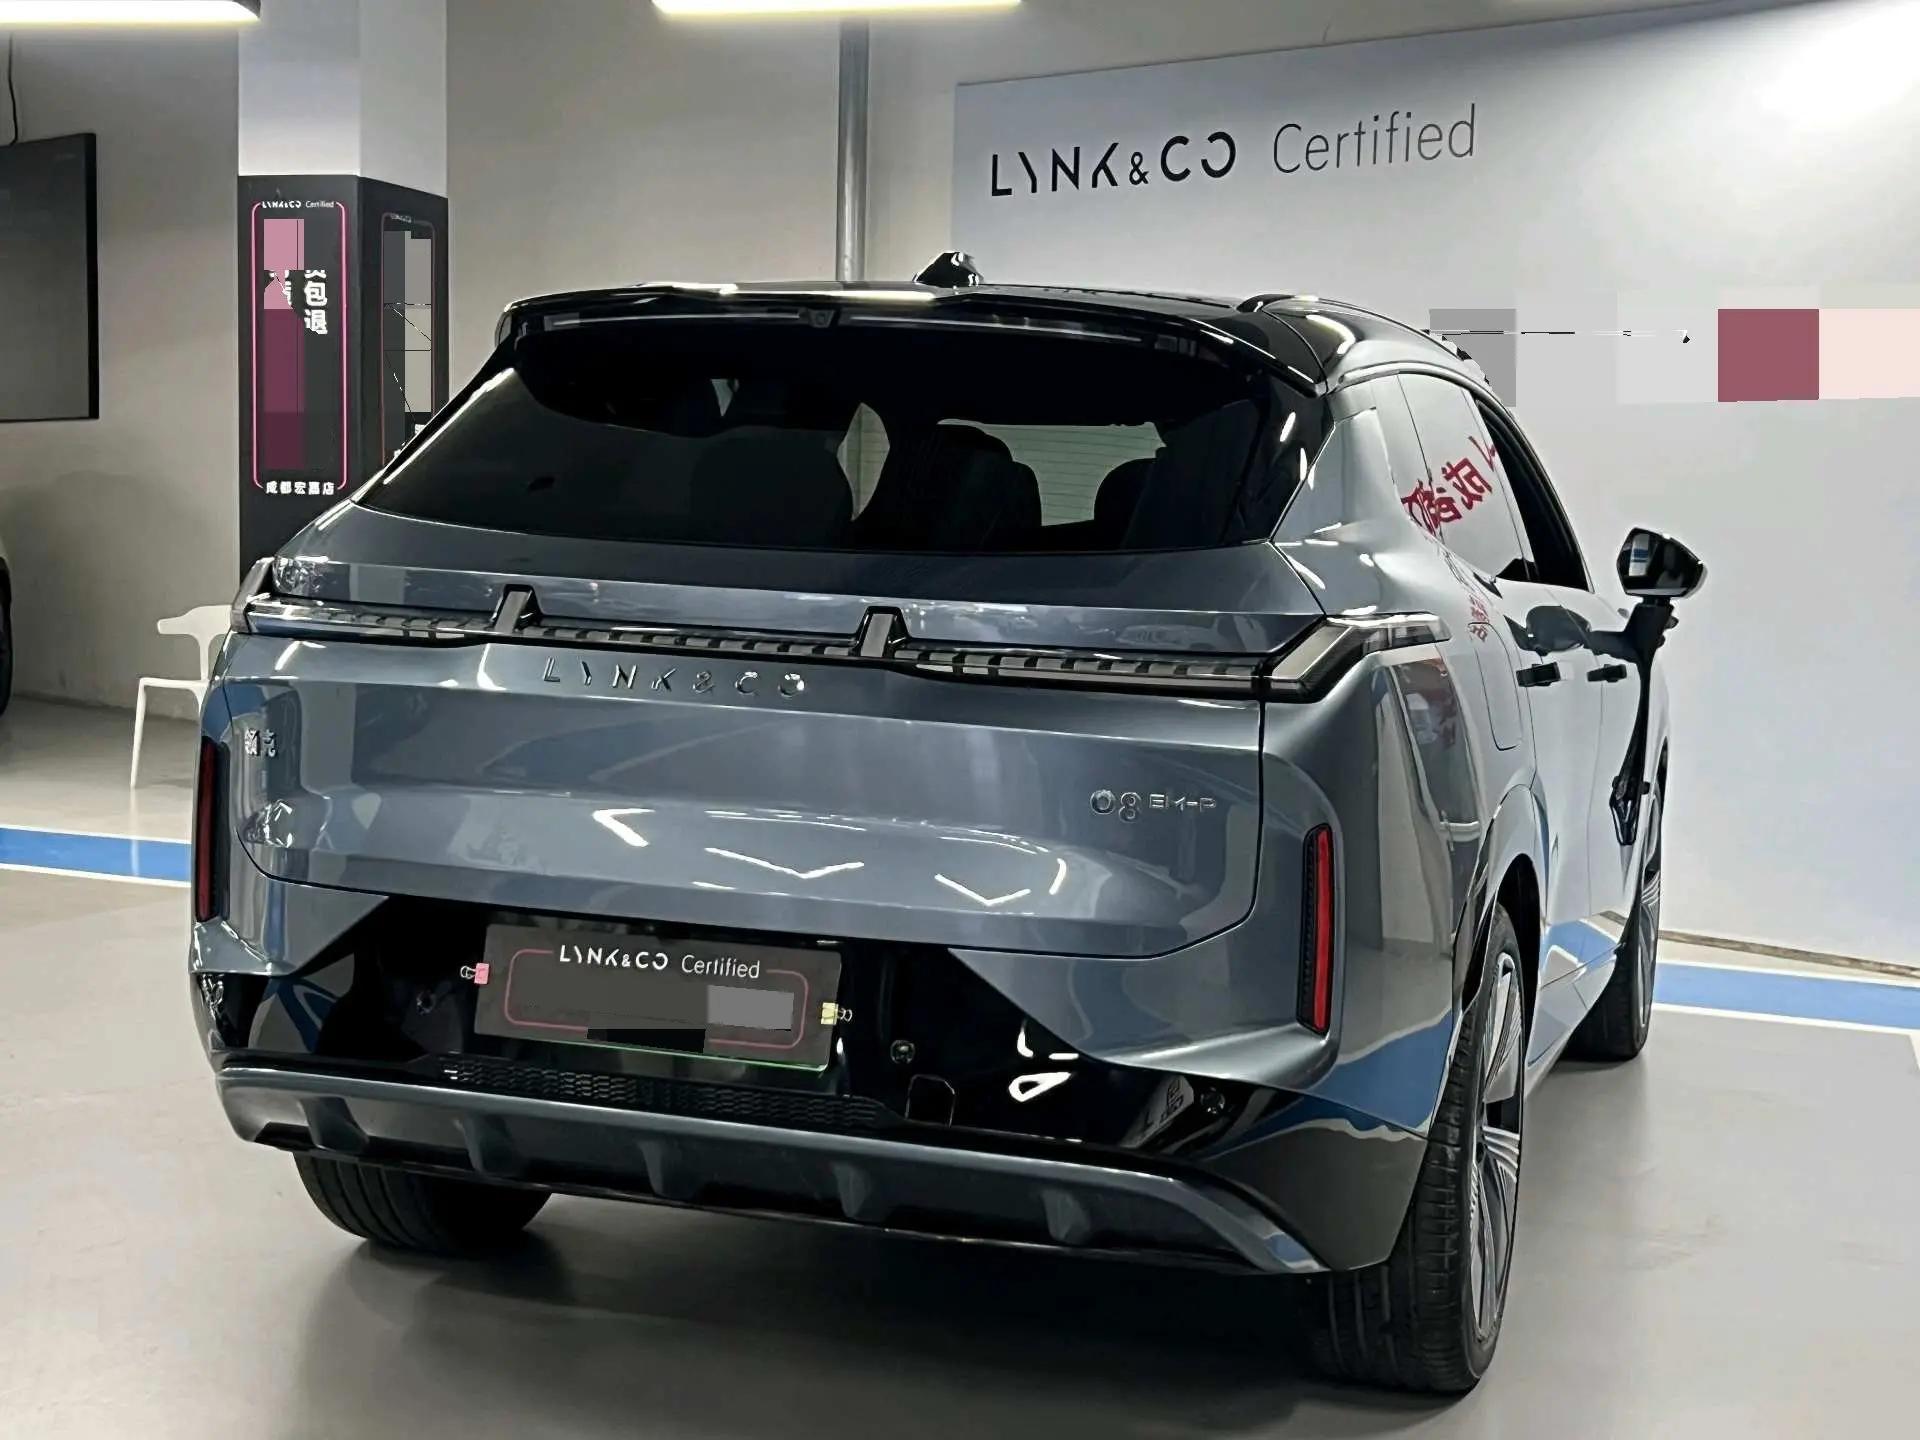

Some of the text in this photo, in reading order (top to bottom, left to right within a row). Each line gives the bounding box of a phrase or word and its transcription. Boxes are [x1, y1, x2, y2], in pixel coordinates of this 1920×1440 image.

[991, 103, 1476, 197] LYNK&CO Certified
[1090, 789, 1142, 824] 08
[559, 944, 761, 979] LYNK&CO Certified
